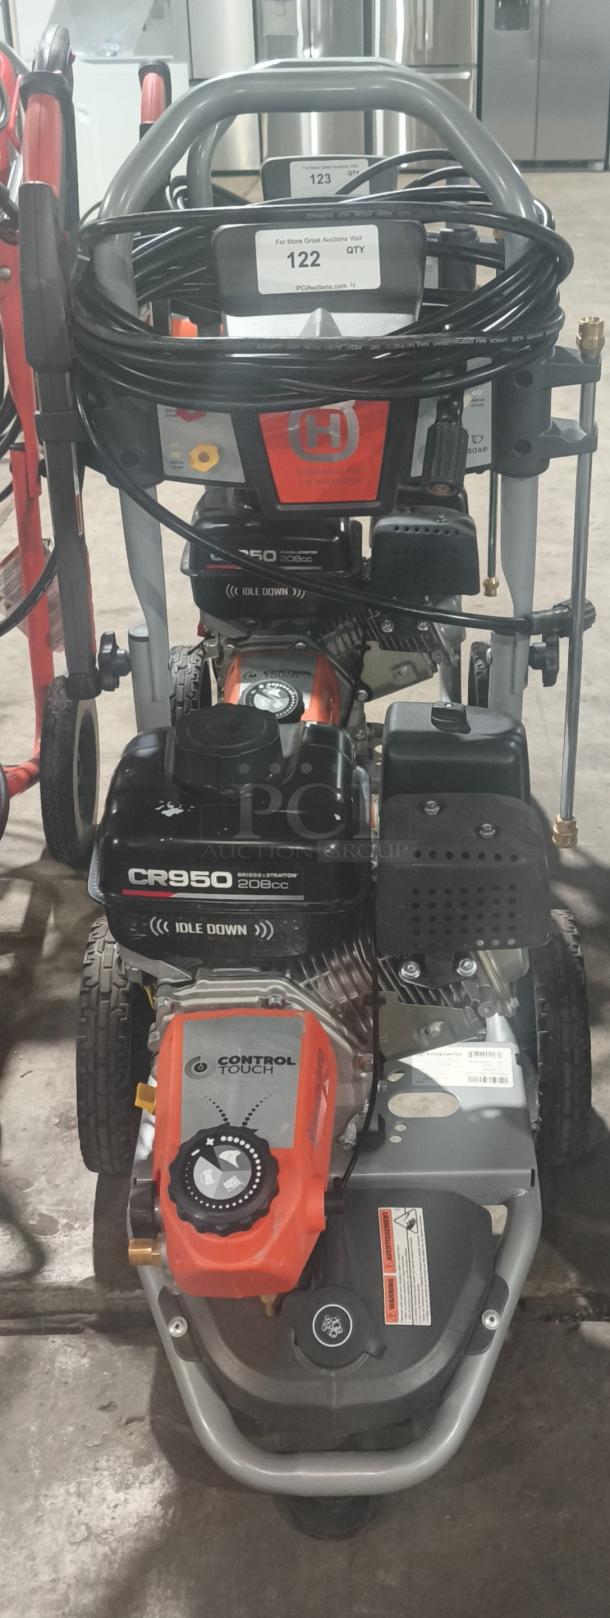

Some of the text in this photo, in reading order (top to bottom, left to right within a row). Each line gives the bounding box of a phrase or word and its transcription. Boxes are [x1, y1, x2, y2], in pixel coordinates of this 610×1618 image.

[309, 173, 332, 185] 123
[287, 237, 303, 245] More
[304, 236, 321, 244] Great
[346, 245, 365, 254] QTY
[287, 250, 321, 268] 122
[242, 587, 288, 596] IDLE DOWN
[127, 867, 233, 888] CR950
[237, 879, 289, 889] 208cc
[175, 922, 247, 936] IDLE DOWN
[217, 1055, 297, 1066] CONTROL
[218, 1065, 275, 1075] TOUCH
